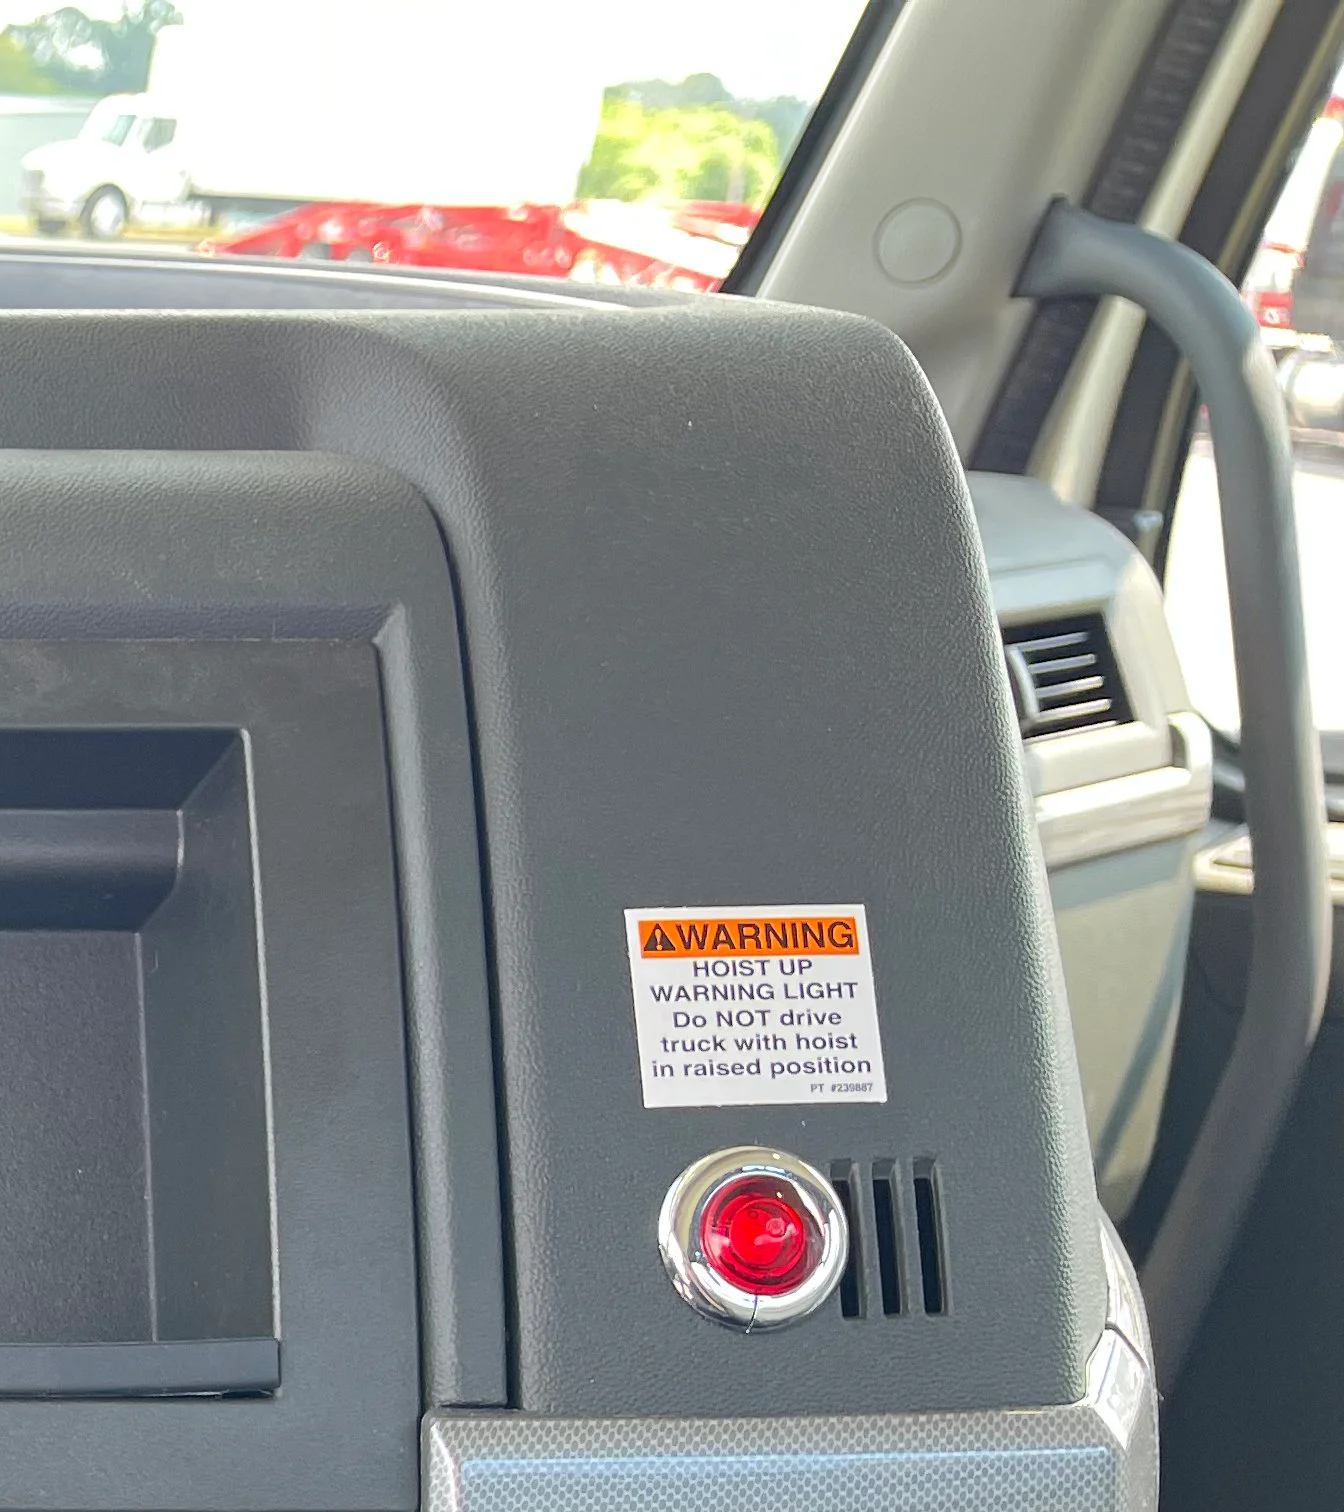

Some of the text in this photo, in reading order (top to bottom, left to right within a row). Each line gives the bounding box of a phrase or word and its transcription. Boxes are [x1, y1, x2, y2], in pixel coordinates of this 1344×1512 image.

[675, 921, 854, 950] WARNING
[692, 959, 813, 977] HOIST UP
[650, 982, 858, 1002] WARNING LIGHT
[672, 1009, 842, 1028] Do NOT drive
[660, 1032, 858, 1053] truck with hoist
[652, 1056, 872, 1079] in raised position
[810, 1083, 825, 1093] PT
